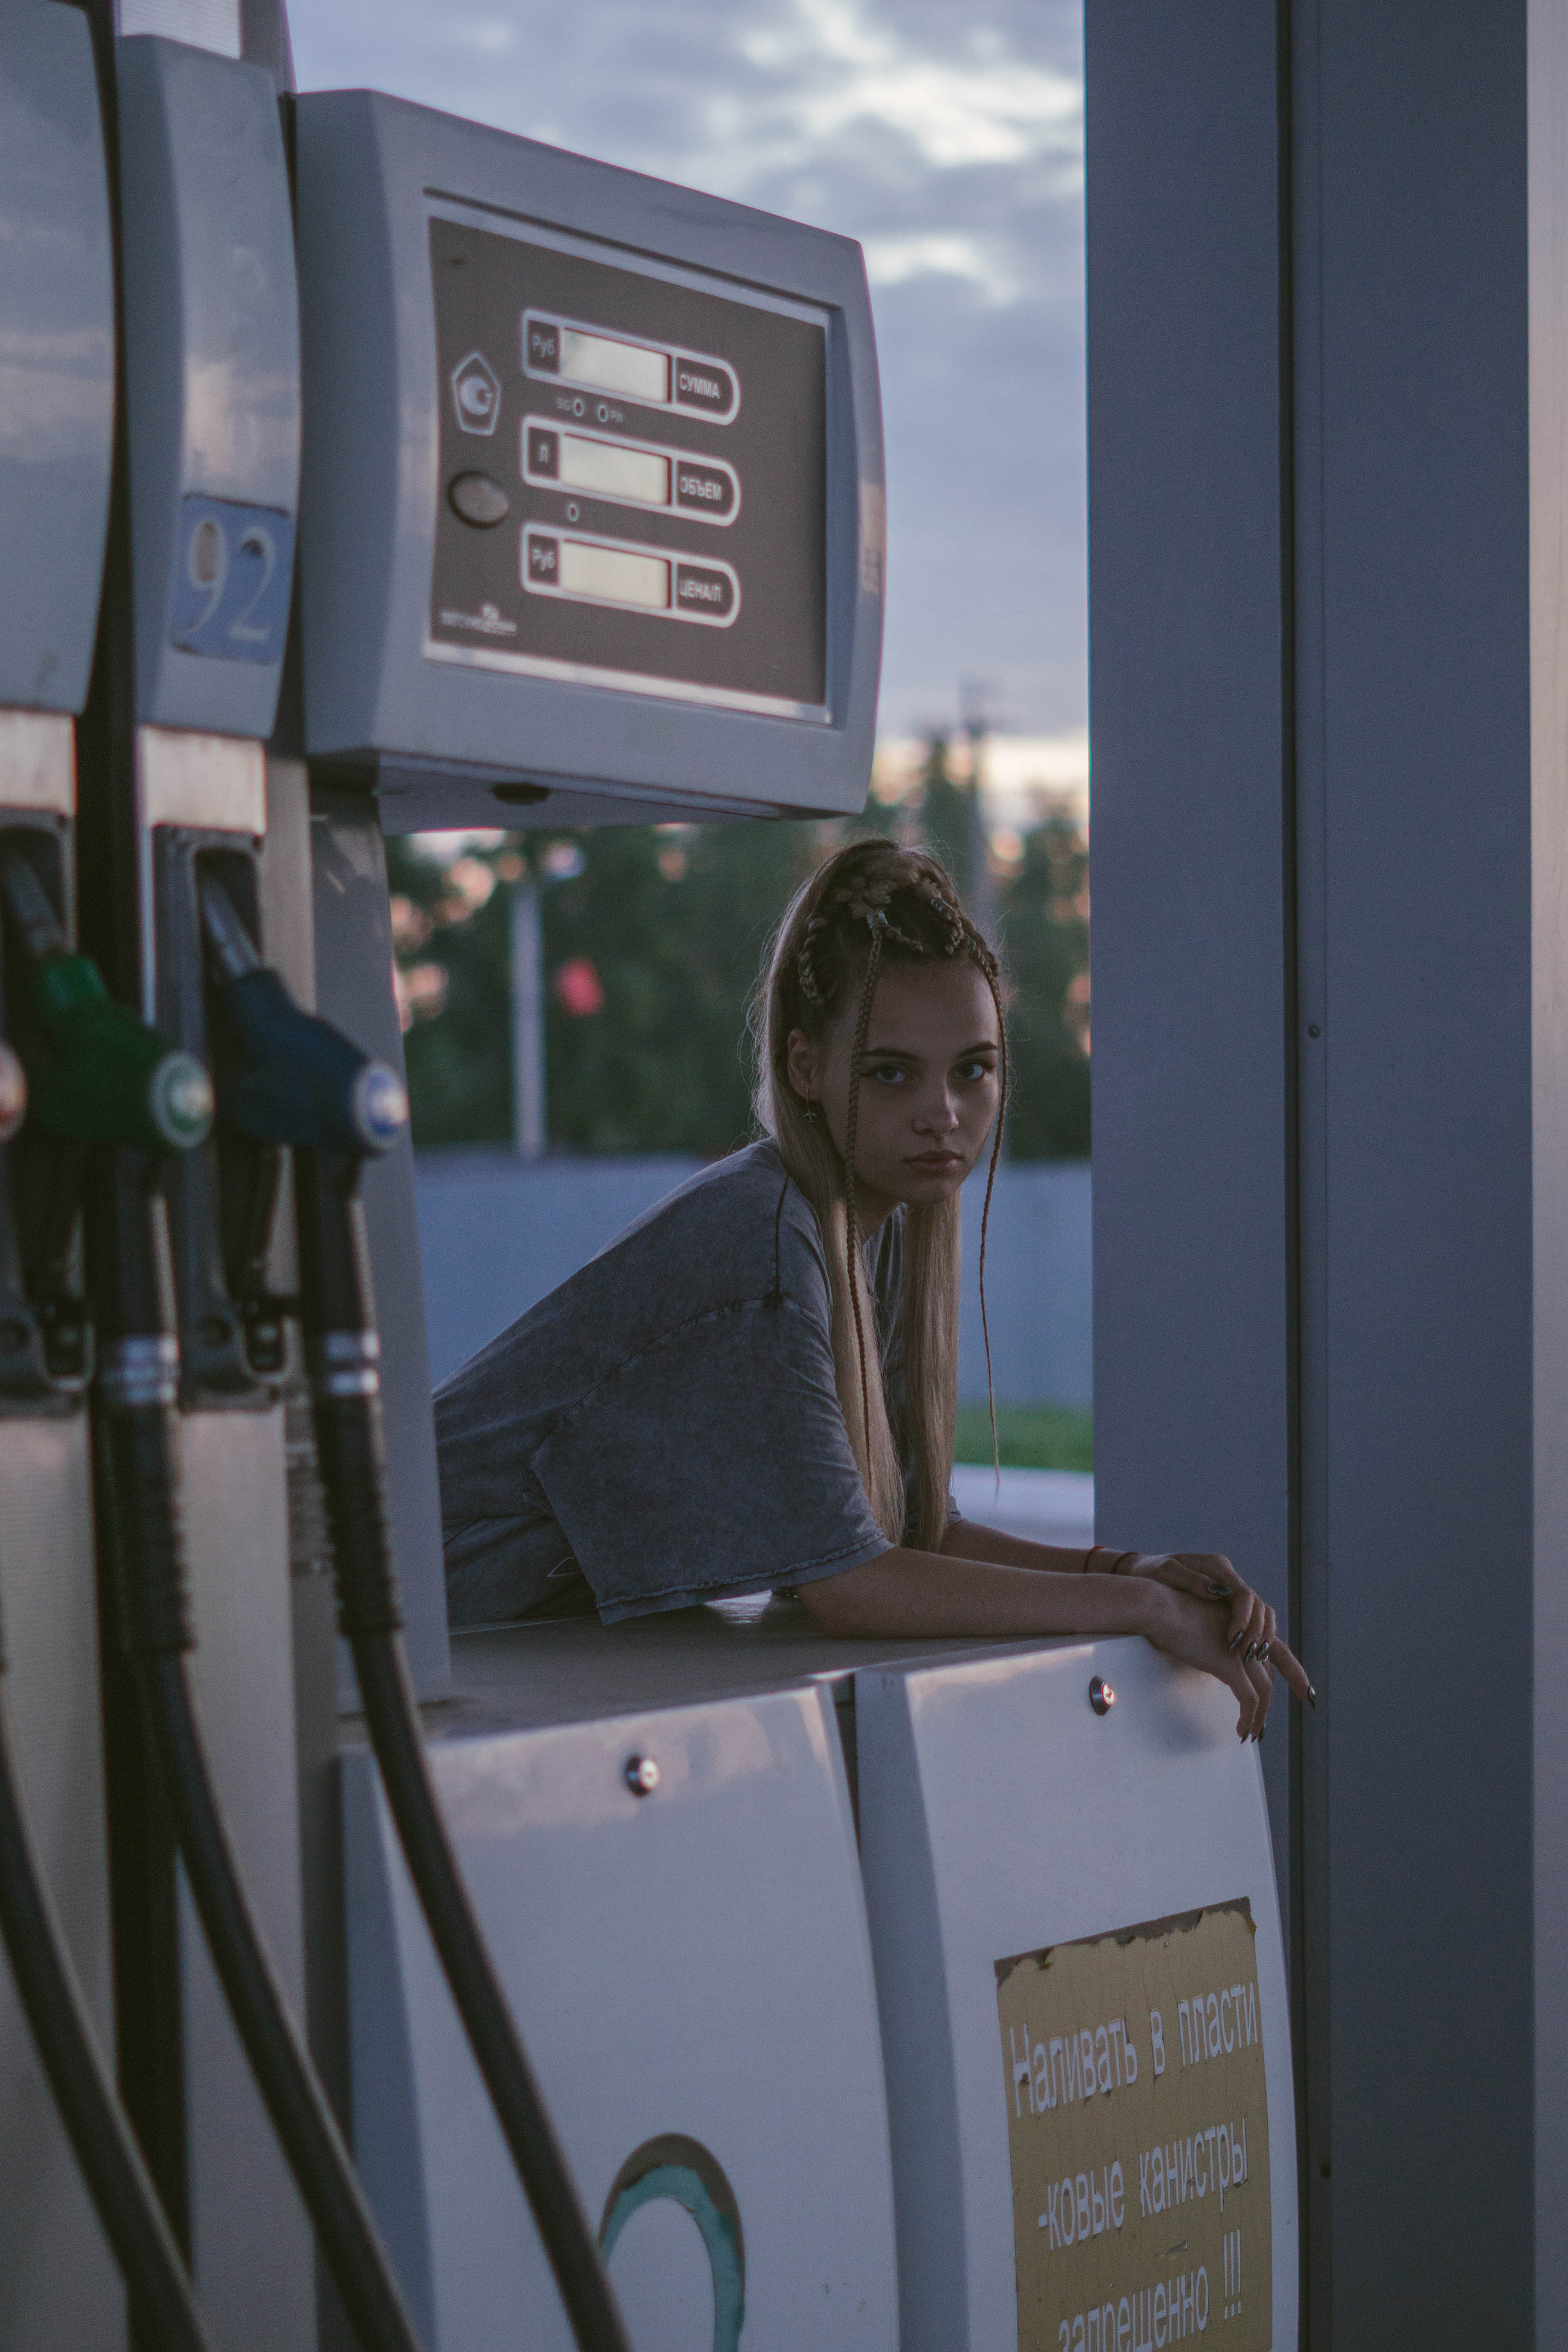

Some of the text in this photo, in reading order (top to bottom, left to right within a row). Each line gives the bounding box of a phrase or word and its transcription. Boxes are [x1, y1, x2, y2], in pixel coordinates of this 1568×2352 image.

[679, 374, 720, 400] СУММА
[680, 477, 722, 501] ОБЪЕМ
[186, 519, 276, 641] 92
[1009, 1982, 1258, 2118] Наливать в пласти
[1038, 2117, 1248, 2251] -ковые канистры
